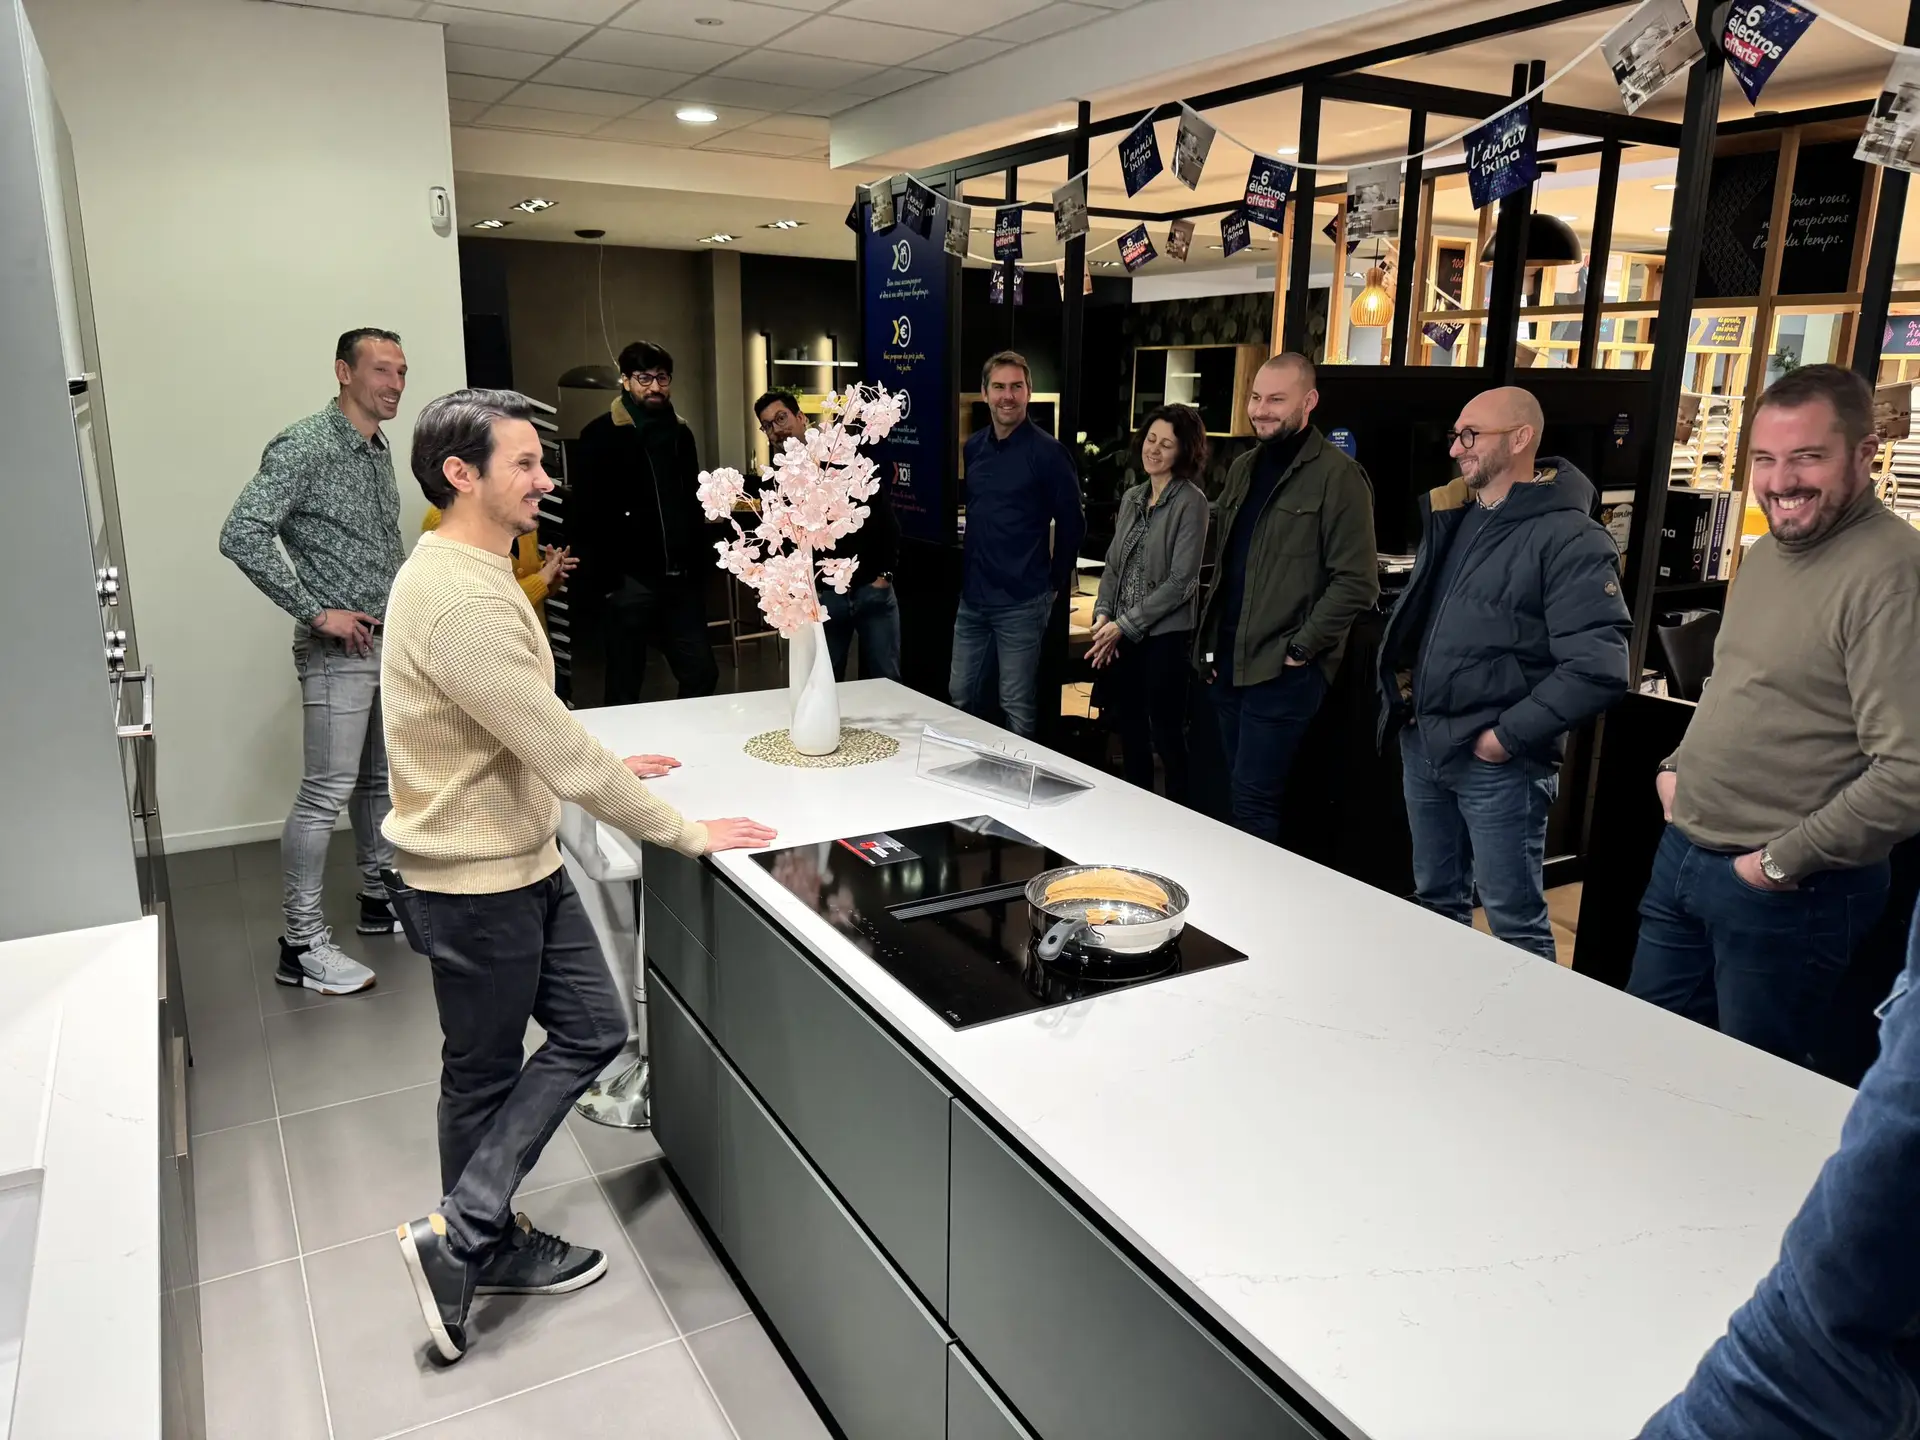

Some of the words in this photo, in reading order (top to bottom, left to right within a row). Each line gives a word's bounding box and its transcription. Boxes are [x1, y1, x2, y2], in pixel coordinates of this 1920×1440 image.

[1746, 4, 1766, 27] 6
[1728, 14, 1783, 60] électros
[1129, 149, 1152, 173] ixina
[1480, 148, 1521, 177] ixina
[1260, 170, 1271, 186] 6
[1248, 179, 1287, 202] électros
[1246, 194, 1275, 209] offerts
[996, 226, 1020, 237] électros
[1002, 216, 1008, 229] 6
[1792, 213, 1849, 233] respirons
[1126, 237, 1134, 248] 6
[1227, 228, 1244, 242] ixina
[1802, 233, 1844, 252] temps.
[1122, 237, 1149, 257] électros
[898, 467, 908, 482] 10
